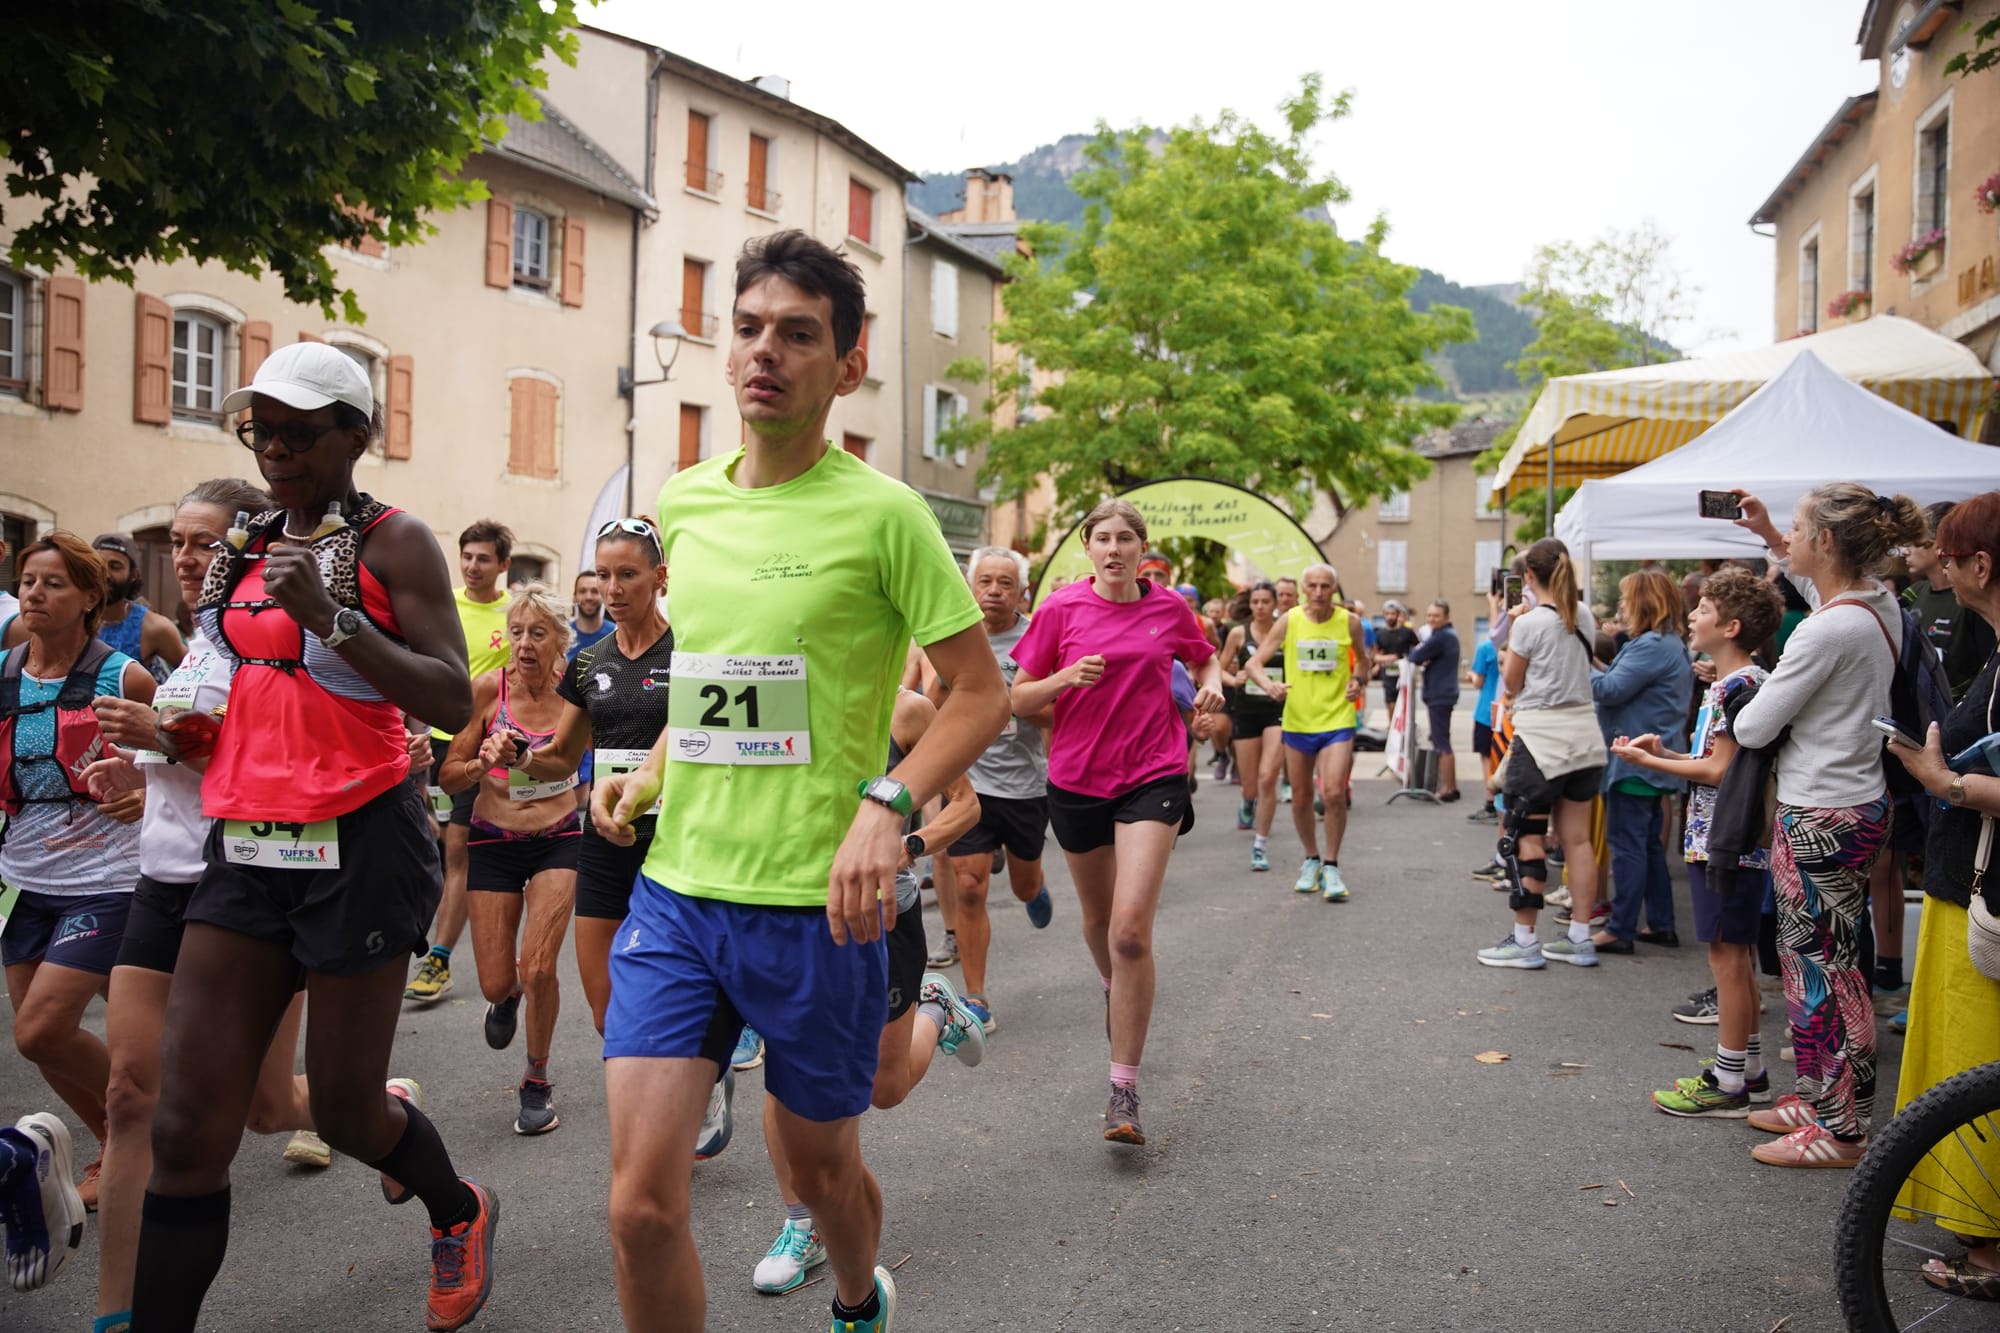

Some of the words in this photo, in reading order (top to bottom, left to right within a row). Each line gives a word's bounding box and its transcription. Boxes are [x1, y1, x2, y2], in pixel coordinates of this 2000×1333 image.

[1214, 499, 1239, 511] des
[1145, 513, 1173, 527] lées
[1307, 648, 1327, 661] 14
[726, 659, 772, 670] Challenge
[777, 659, 794, 667] des
[700, 684, 759, 728] 21
[736, 741, 781, 751] TUFF'S
[70, 732, 104, 777] KINE
[740, 748, 785, 757] Aventure
[278, 849, 315, 858] TUFF'S
[282, 855, 320, 863] Aventure
